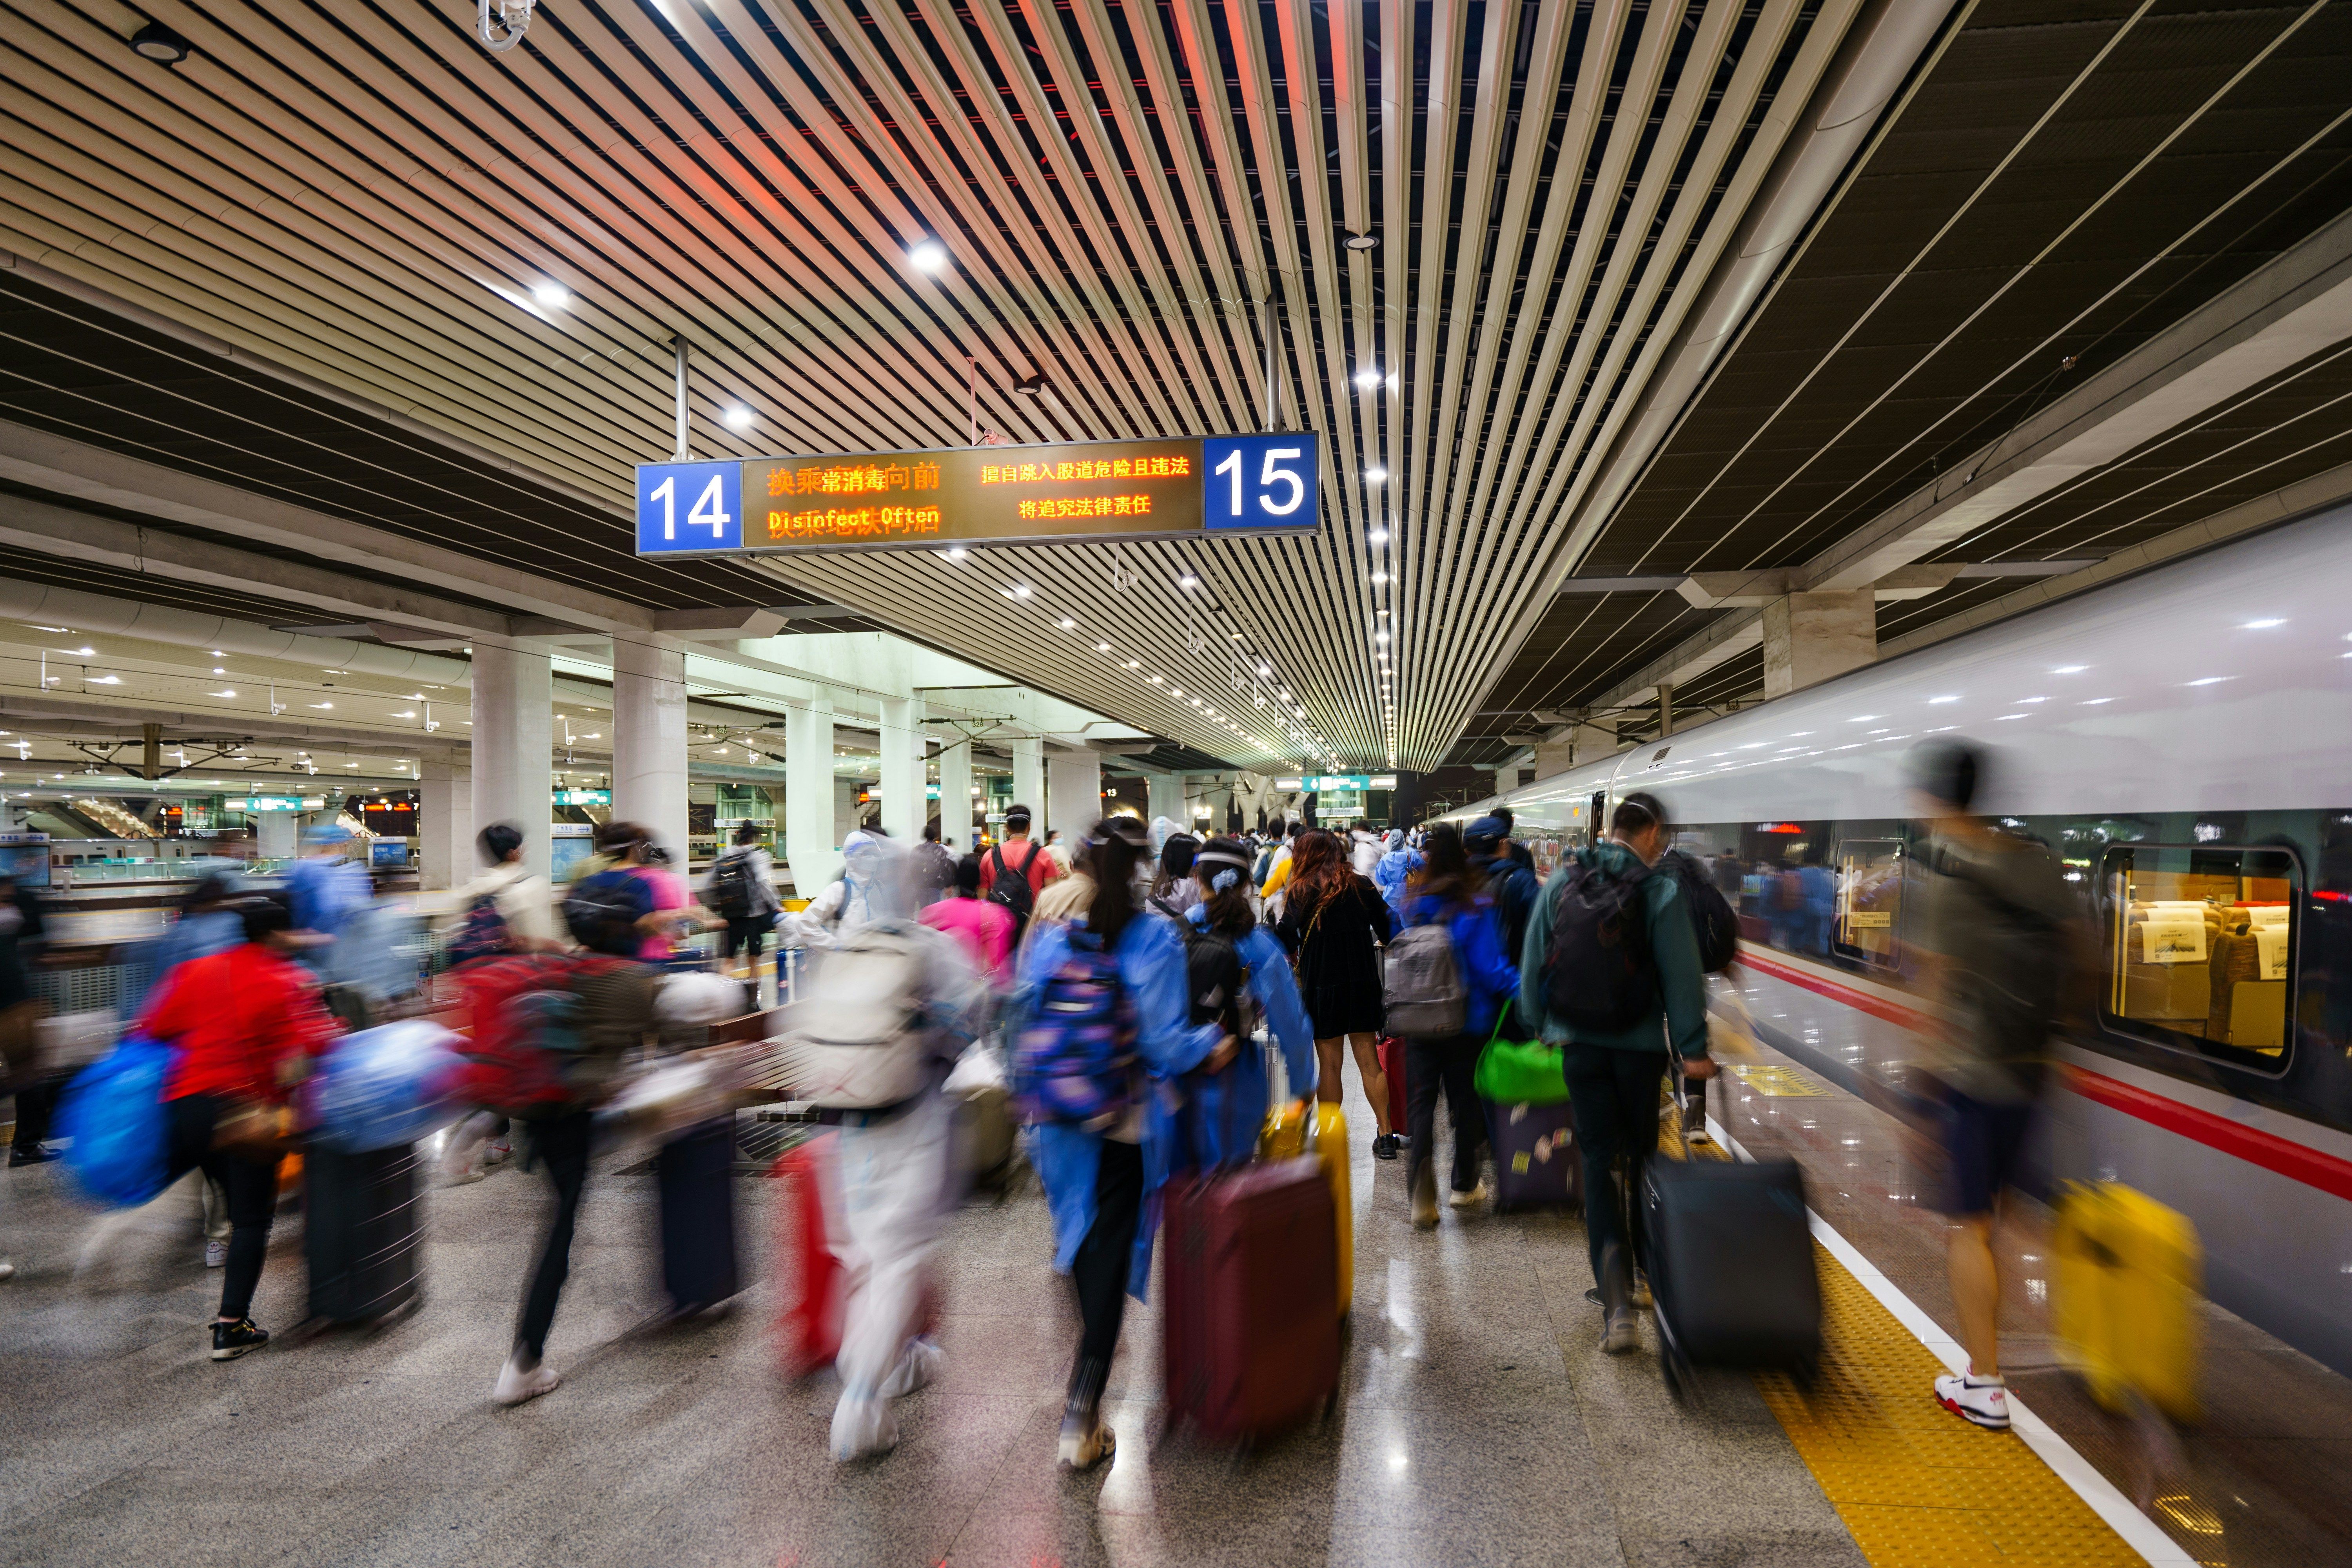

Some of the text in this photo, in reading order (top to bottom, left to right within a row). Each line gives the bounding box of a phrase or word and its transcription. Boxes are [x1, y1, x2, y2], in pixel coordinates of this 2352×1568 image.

[981, 456, 1189, 483] 擅自跳入股道危险且违法
[1215, 448, 1304, 515] 15
[650, 475, 730, 540] 14
[769, 507, 940, 529] Disinfect Often
[1019, 495, 1151, 519] 将追究法律责任
[1107, 788, 1117, 797] 13
